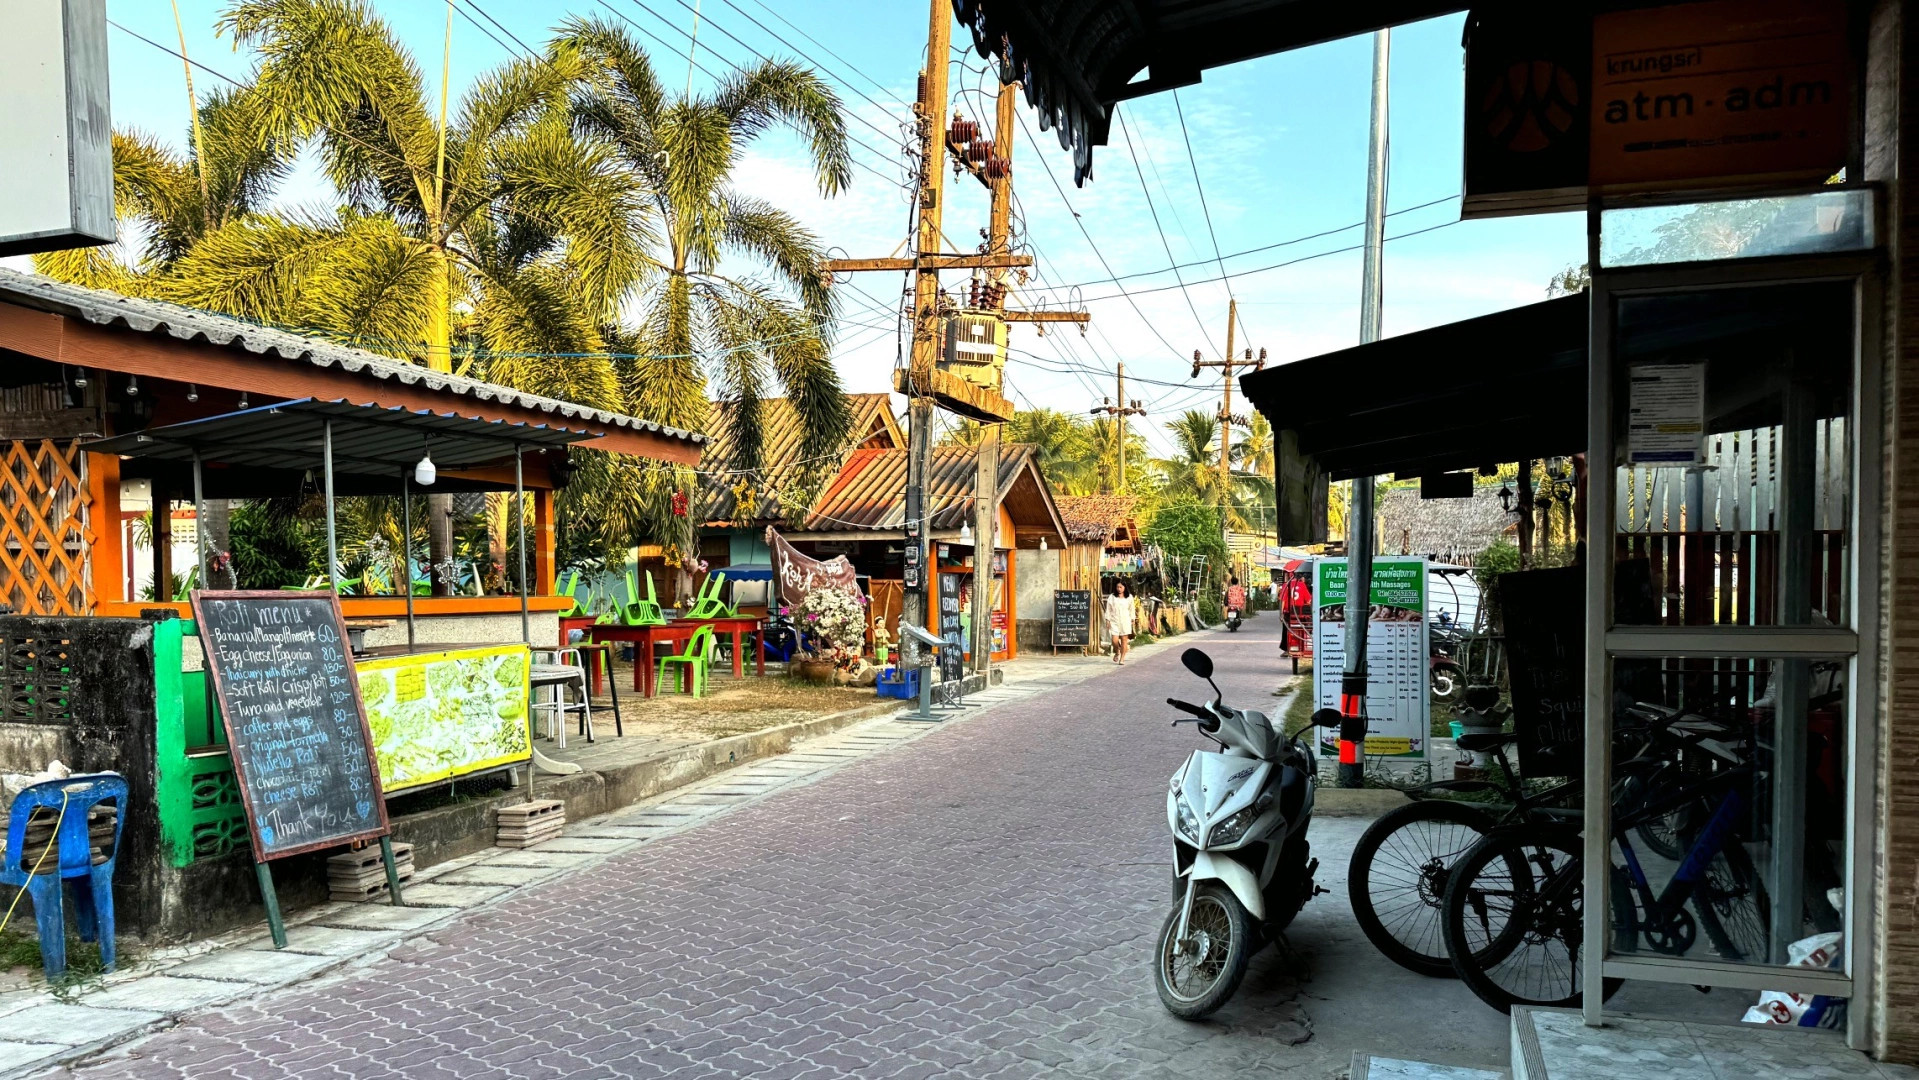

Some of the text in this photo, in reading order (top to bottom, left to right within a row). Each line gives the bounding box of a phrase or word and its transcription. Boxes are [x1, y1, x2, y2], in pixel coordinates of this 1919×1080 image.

[1606, 47, 1703, 76] krungsri
[1604, 75, 1831, 125] atm adm
[1329, 581, 1345, 589] Baan
[1381, 581, 1411, 589] Massages
[215, 600, 304, 627] Roti menu
[1538, 695, 1585, 722] Squi
[267, 801, 314, 840] Thank
